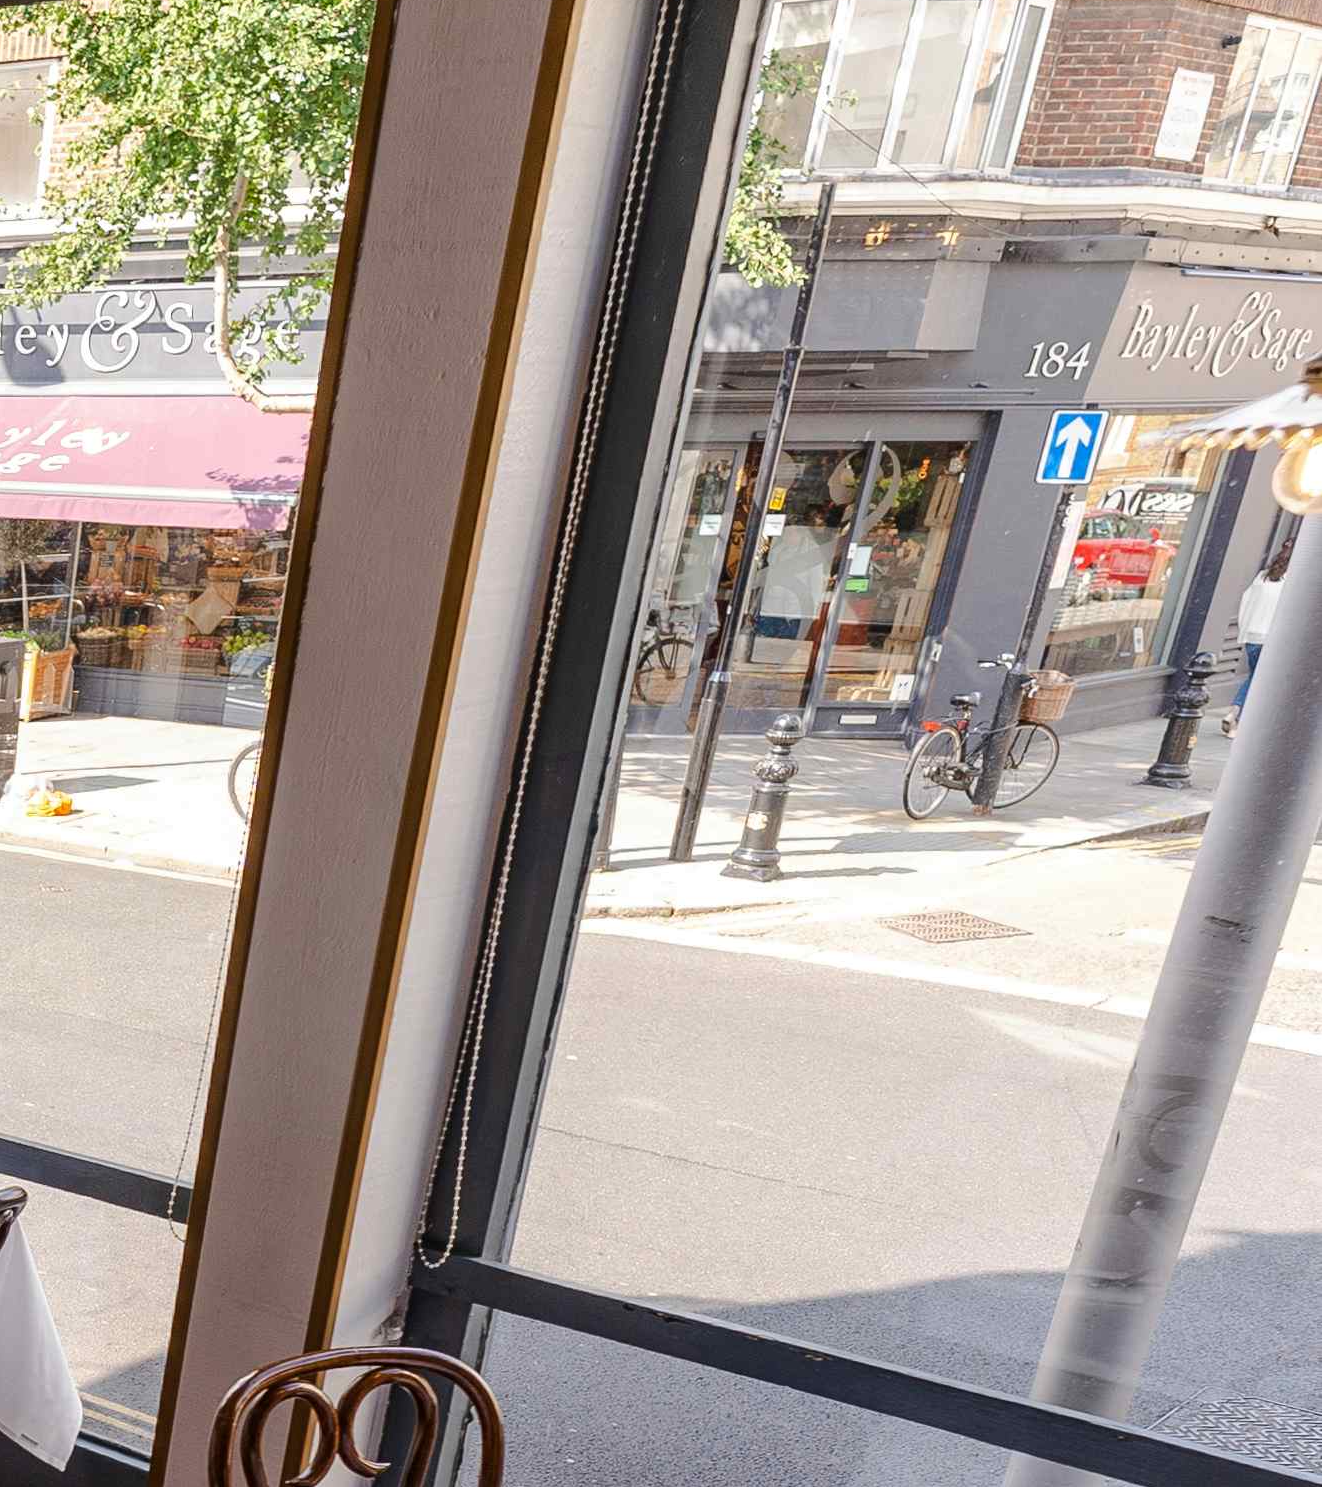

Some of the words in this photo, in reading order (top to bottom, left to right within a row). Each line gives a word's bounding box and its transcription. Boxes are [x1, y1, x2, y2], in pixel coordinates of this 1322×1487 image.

[80, 290, 157, 373] &
[1023, 341, 1092, 381] 184
[1121, 302, 1222, 373] Bayley
[1210, 290, 1273, 378] &
[1251, 308, 1316, 372] Sage
